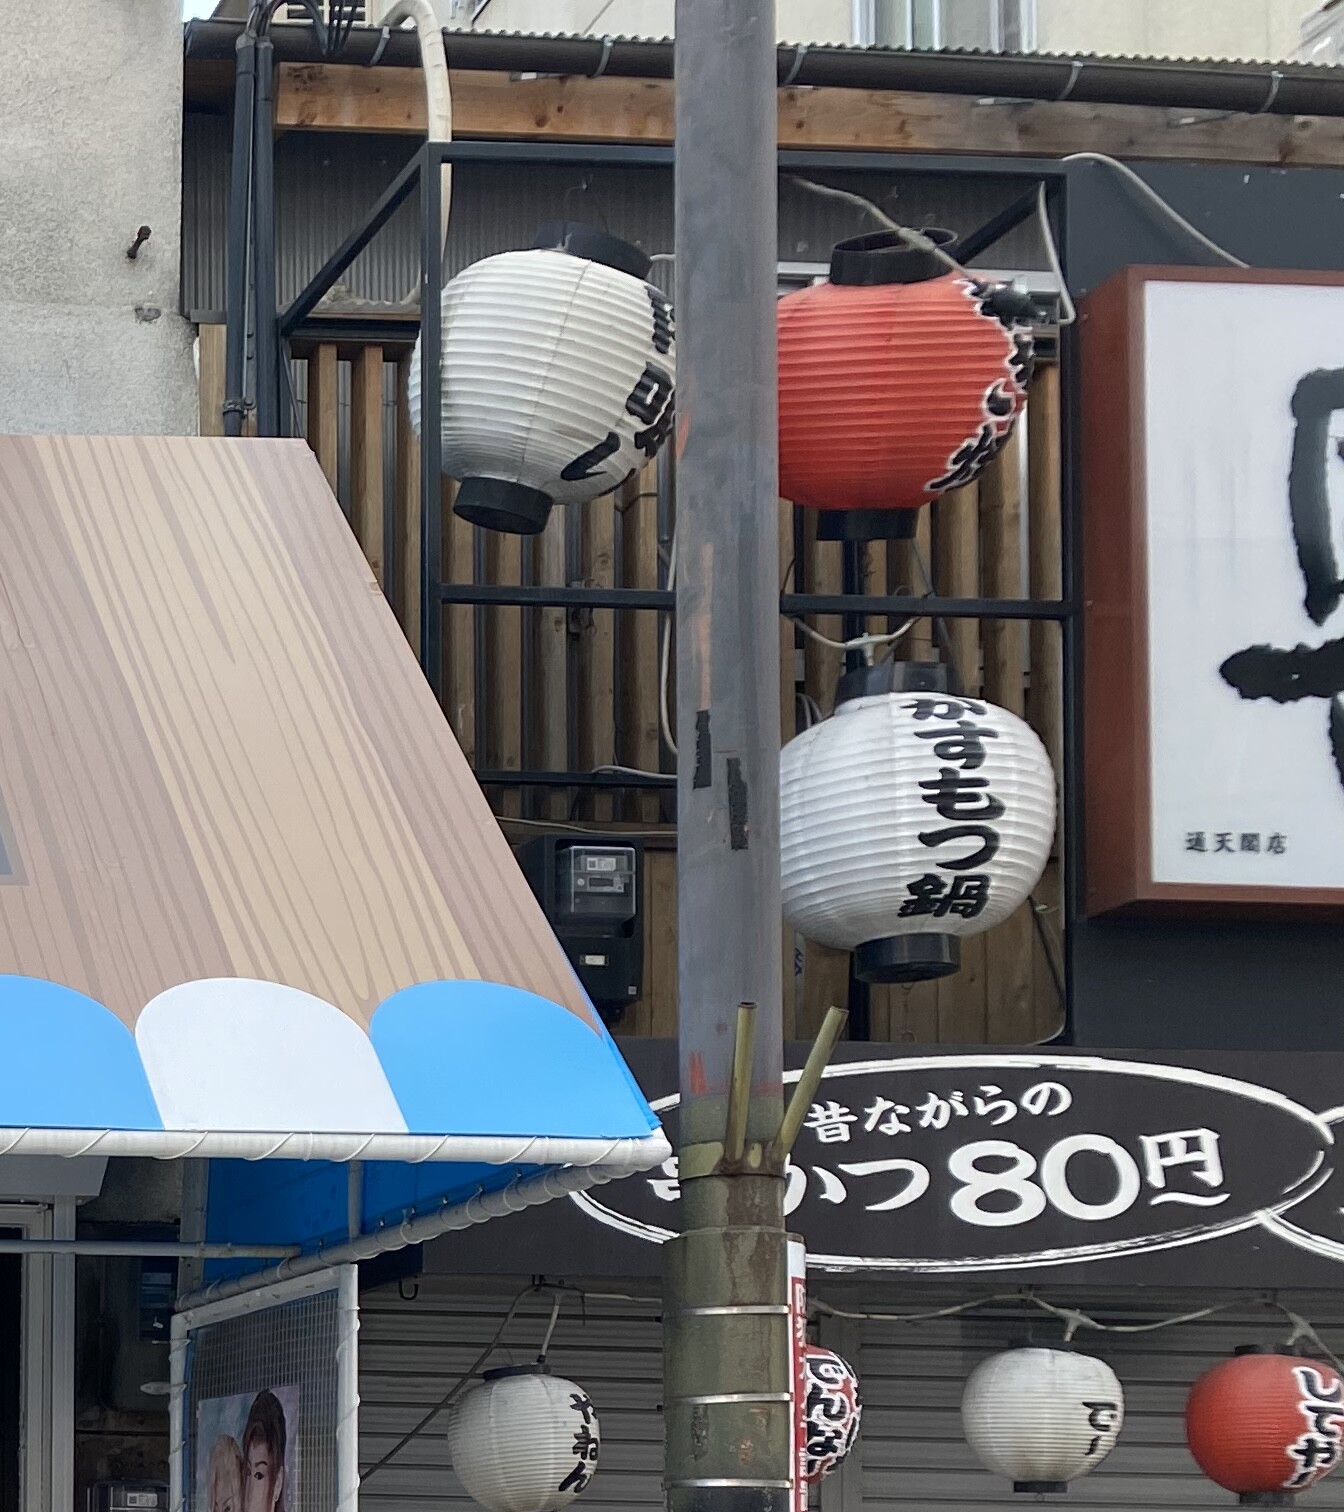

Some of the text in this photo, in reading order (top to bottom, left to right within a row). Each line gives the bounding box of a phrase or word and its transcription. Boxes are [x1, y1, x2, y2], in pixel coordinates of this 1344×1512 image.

[899, 695, 1005, 922] かすもつ鍋
[1185, 831, 1288, 854] 通天閣店
[804, 1077, 1074, 1145] 昔ながらの
